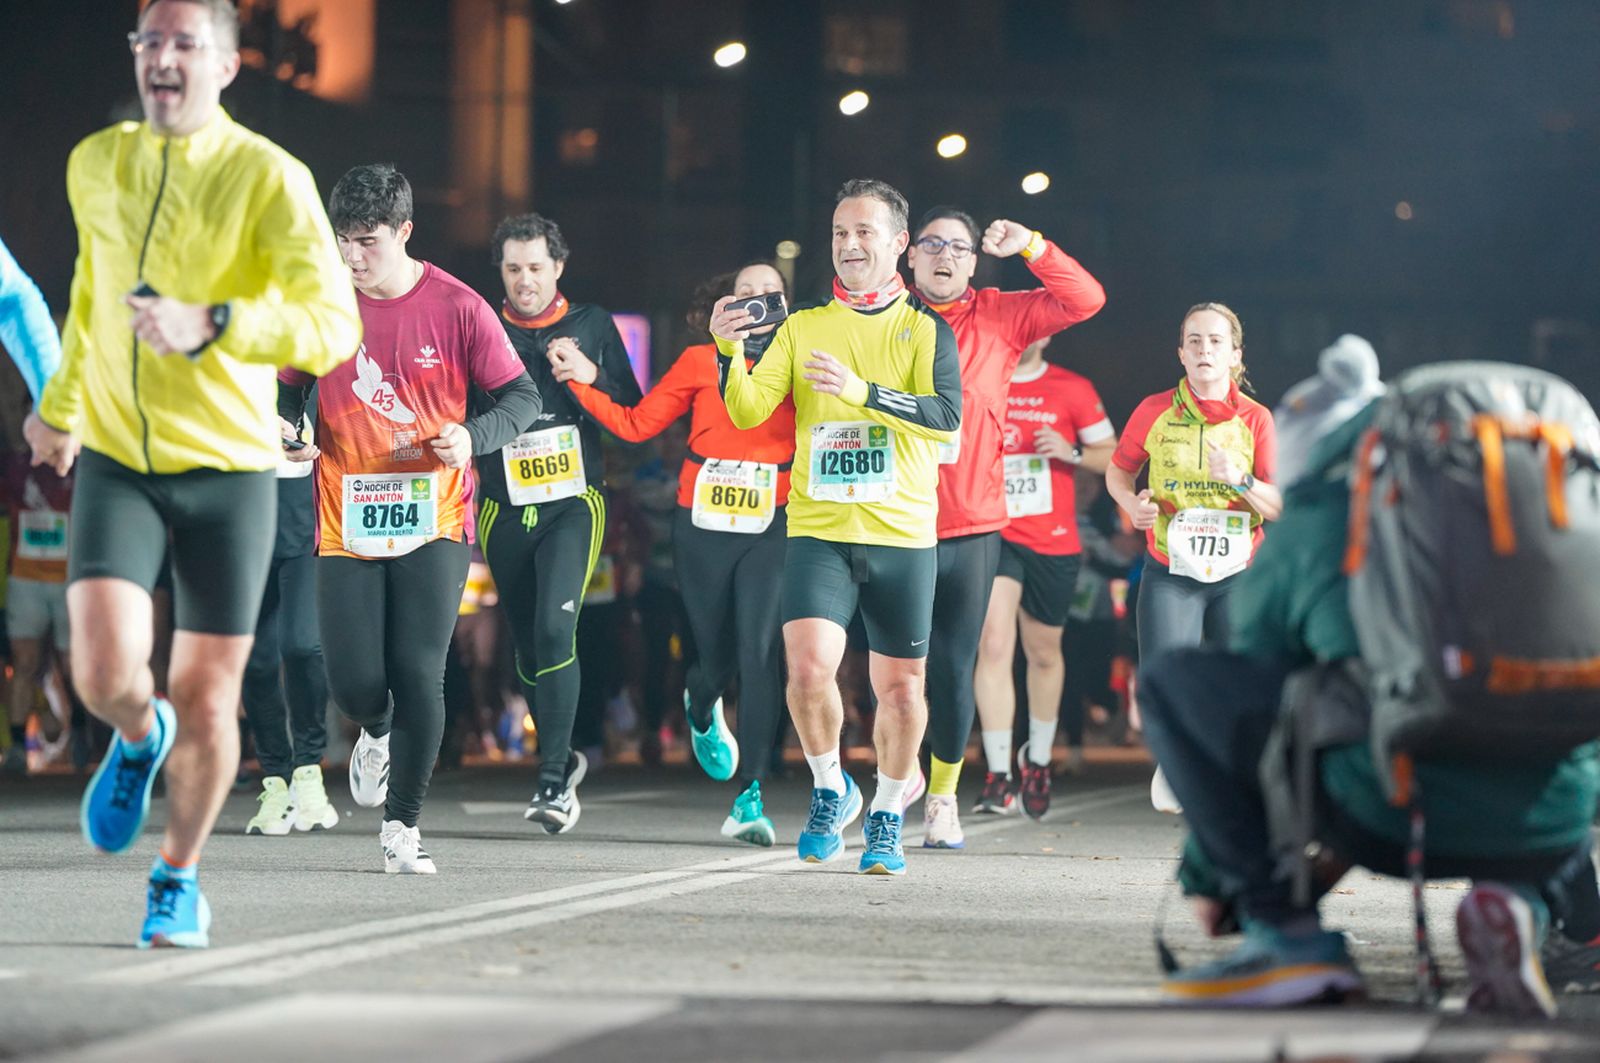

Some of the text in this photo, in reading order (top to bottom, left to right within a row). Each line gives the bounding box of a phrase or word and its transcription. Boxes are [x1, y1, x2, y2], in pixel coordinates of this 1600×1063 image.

[371, 388, 395, 412] 43
[850, 430, 861, 438] DE
[833, 439, 862, 449] ANTÓN
[519, 453, 570, 480] 8669
[821, 449, 885, 476] 12680
[364, 483, 391, 492] NOCHE
[392, 482, 403, 492] DE
[1184, 481, 1233, 491] HYUND
[353, 494, 373, 504] SAN
[373, 492, 404, 503] ANTÓN
[711, 485, 760, 509] 8670
[362, 503, 419, 529] 8764
[388, 528, 413, 536] ALBERTO
[1188, 535, 1230, 557] 1779
